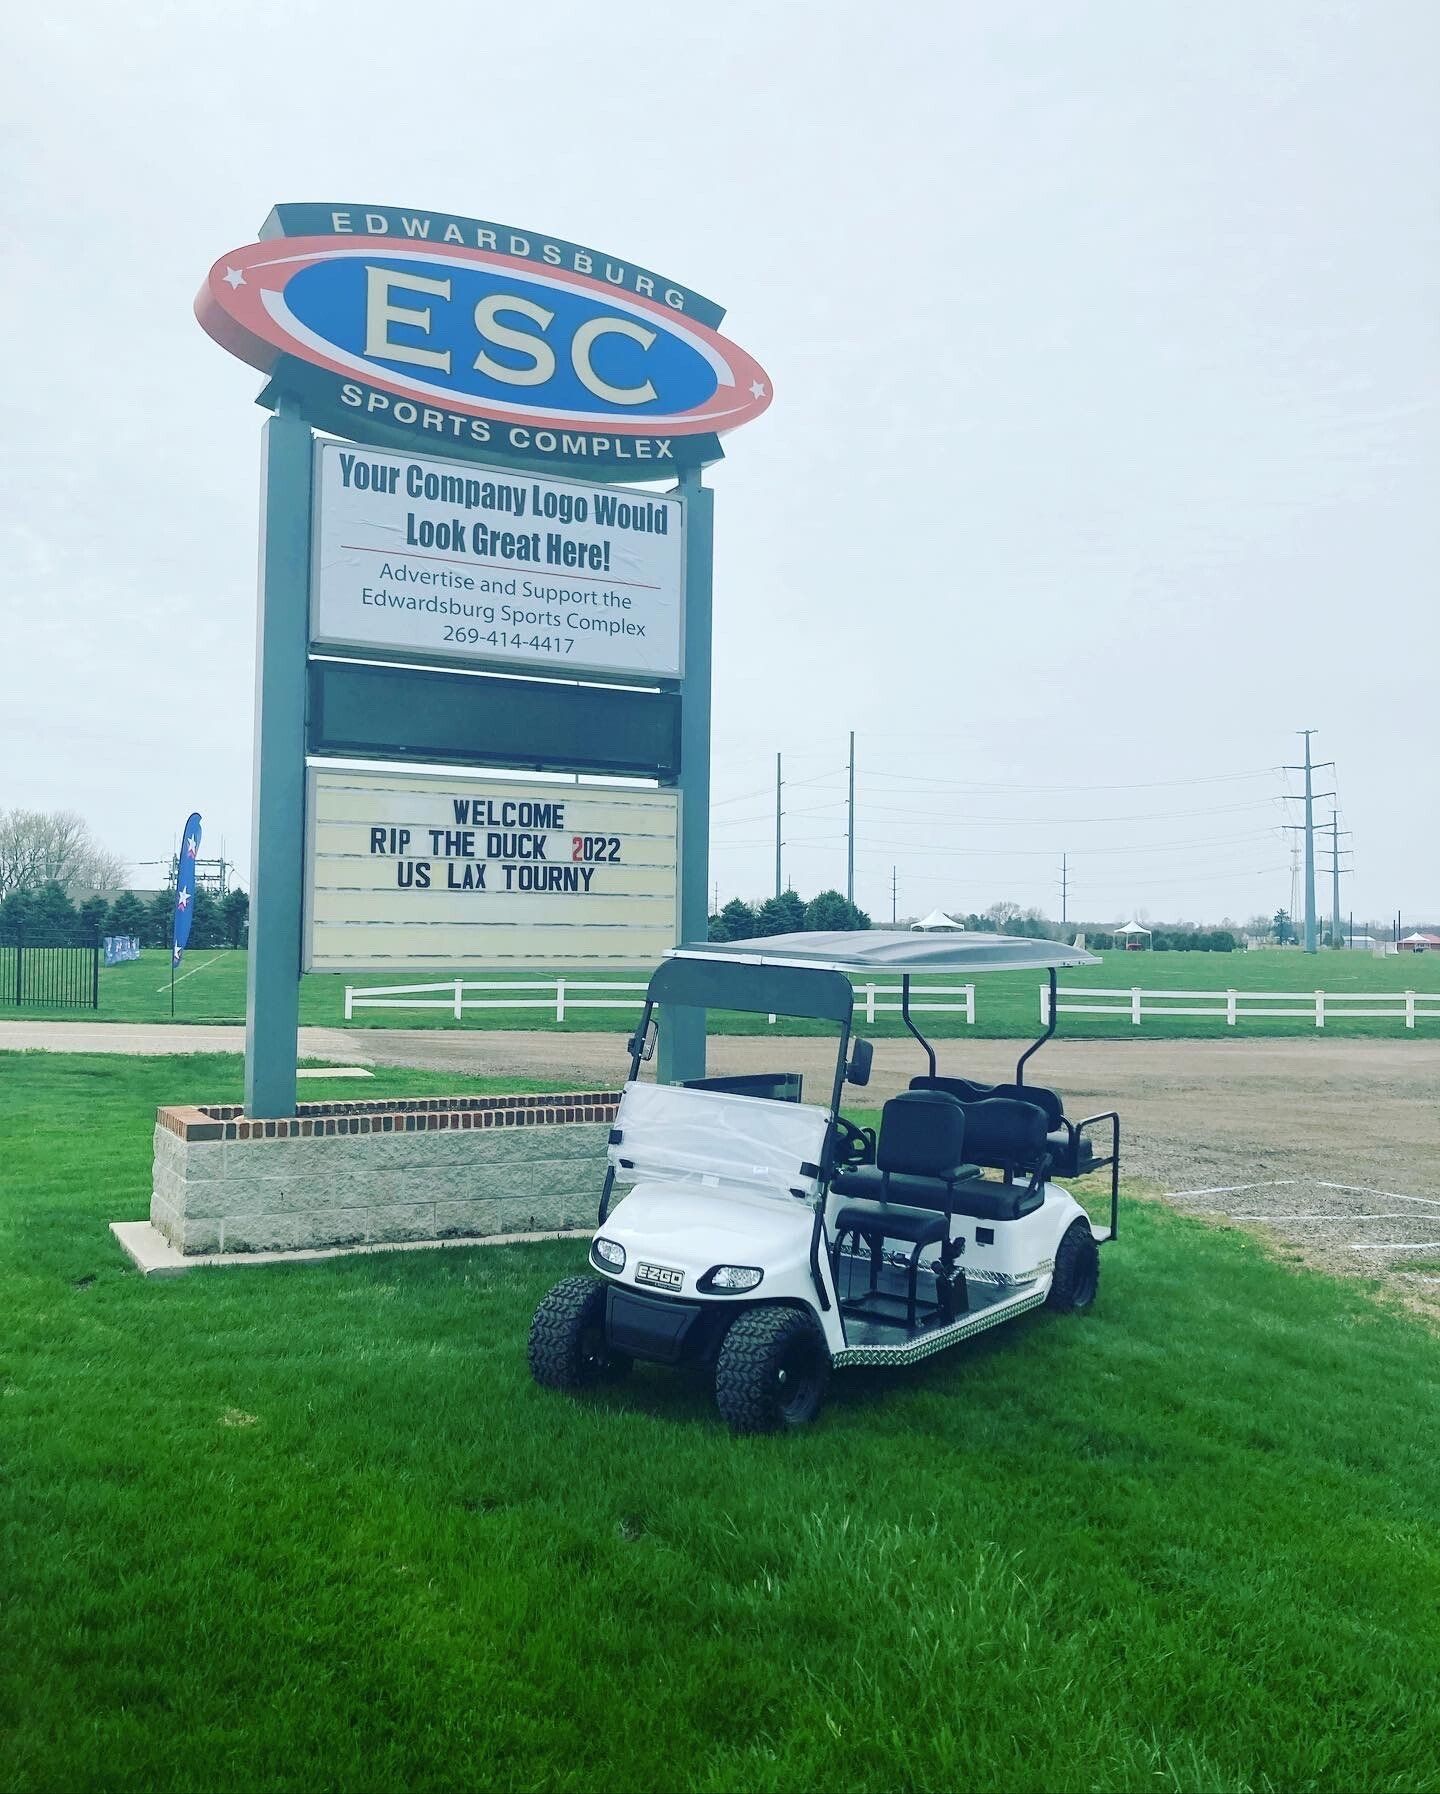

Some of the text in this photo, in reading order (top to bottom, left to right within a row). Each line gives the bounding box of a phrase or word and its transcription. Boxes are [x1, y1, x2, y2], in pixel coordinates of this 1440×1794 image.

[331, 211, 686, 311] EDWARDSBURG
[363, 265, 659, 405] ESC
[340, 383, 674, 459] SPORTS COMPLEX
[338, 453, 668, 535] Your Company Logo Would
[407, 512, 611, 571] Look Great Here!
[380, 562, 632, 610] Advertise and Support the
[362, 587, 646, 637] Edwardsburg Sports Complex
[443, 625, 575, 654] 269-414-4417
[453, 799, 565, 829] WELCOME
[370, 827, 621, 862] RIP THE DUCK 2022
[397, 861, 595, 892] US LAX TOURNY
